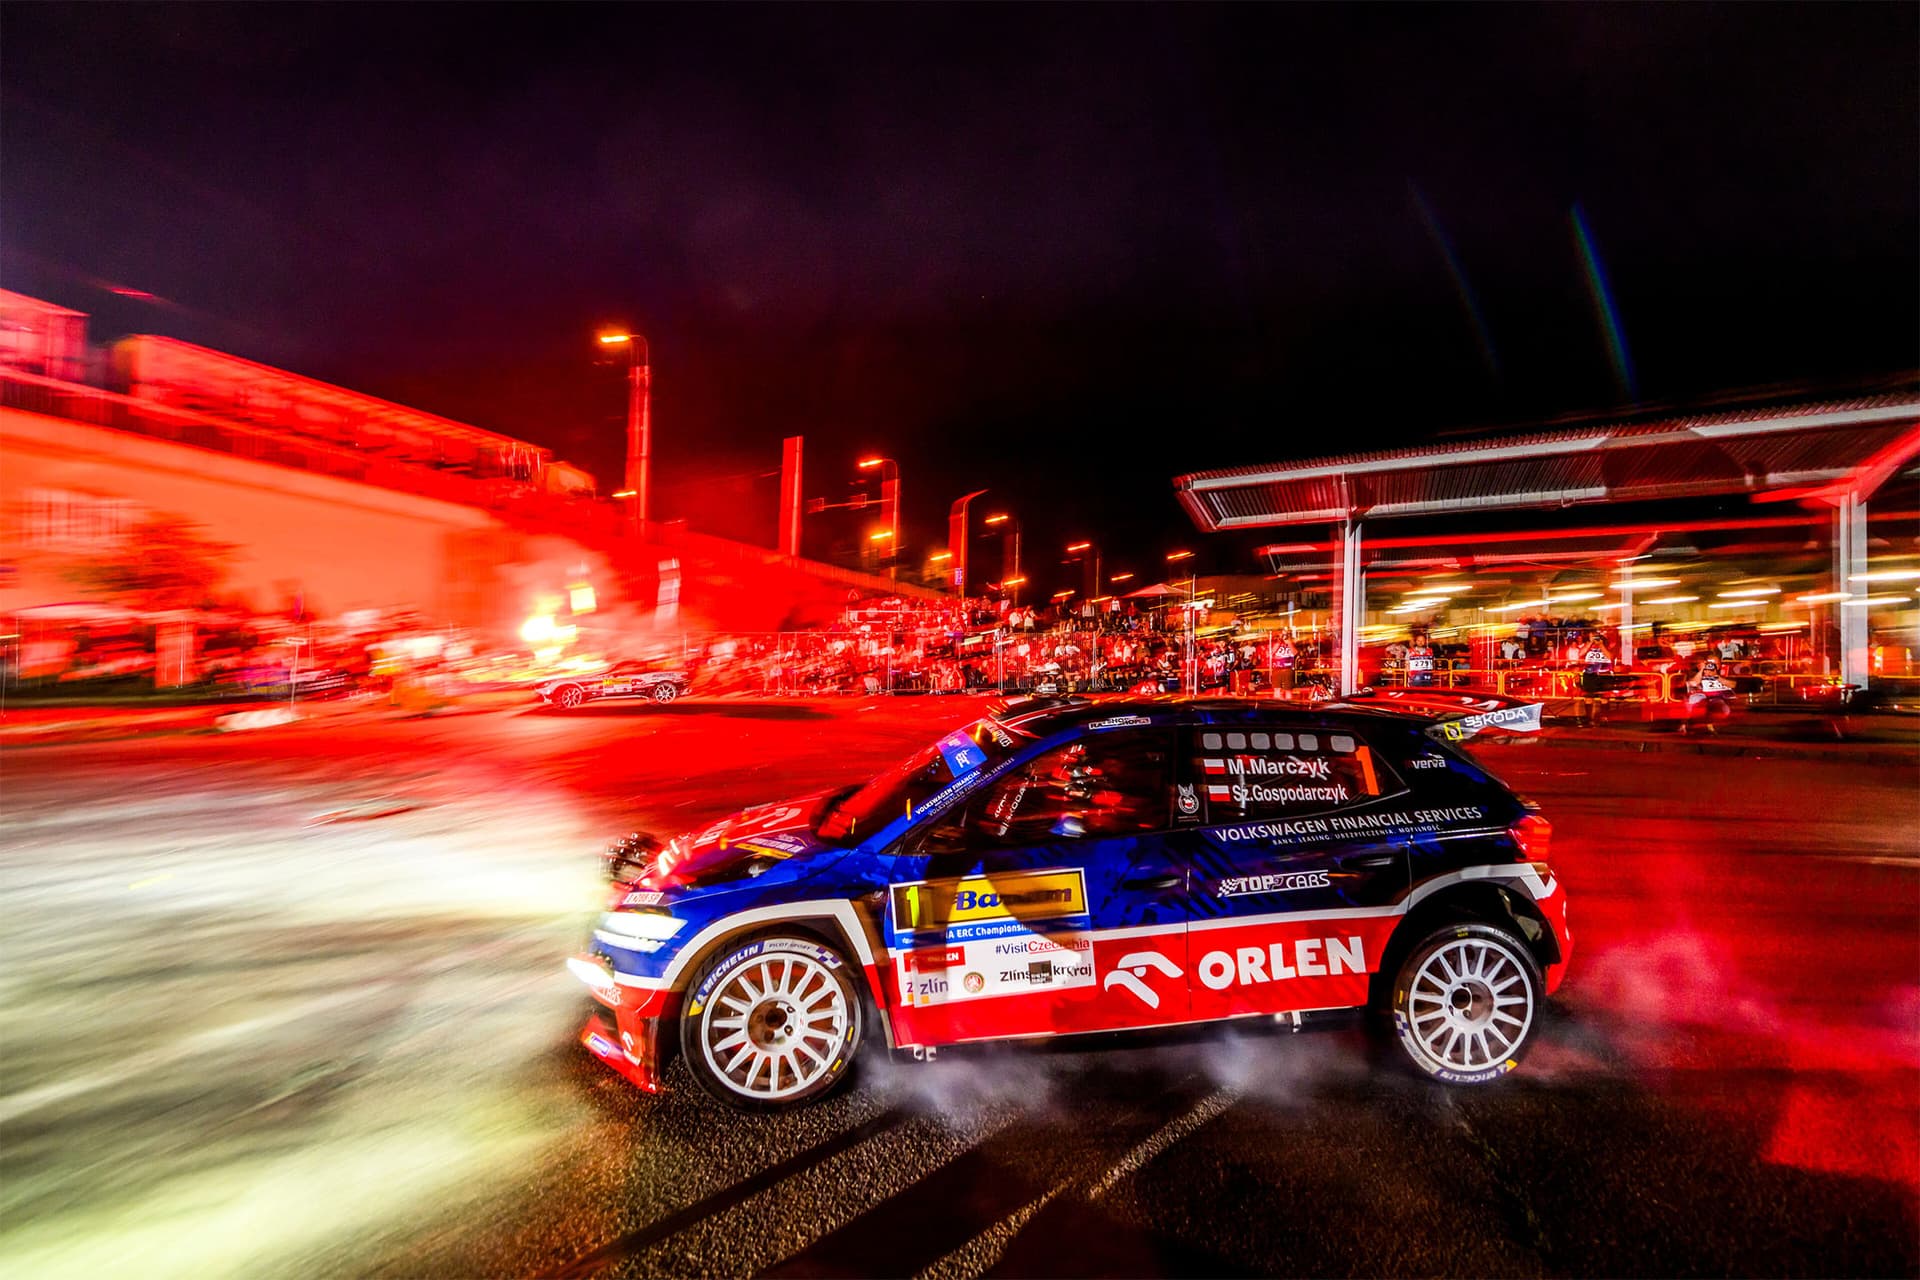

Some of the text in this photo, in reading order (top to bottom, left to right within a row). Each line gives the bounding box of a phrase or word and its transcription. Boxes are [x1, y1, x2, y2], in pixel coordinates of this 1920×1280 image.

[1227, 757, 1331, 778] M.Marczyk
[1356, 746, 1379, 795] 1
[1232, 784, 1349, 805] Sz.Gospodarczyk
[1215, 806, 1483, 843] VOLKSWAGEN FINANCIAL SERVICES
[1285, 873, 1331, 889] CARS
[906, 885, 920, 928] 1
[957, 927, 974, 938] ERC
[703, 945, 759, 993] MICHELIN
[1199, 935, 1367, 990] ORLEN
